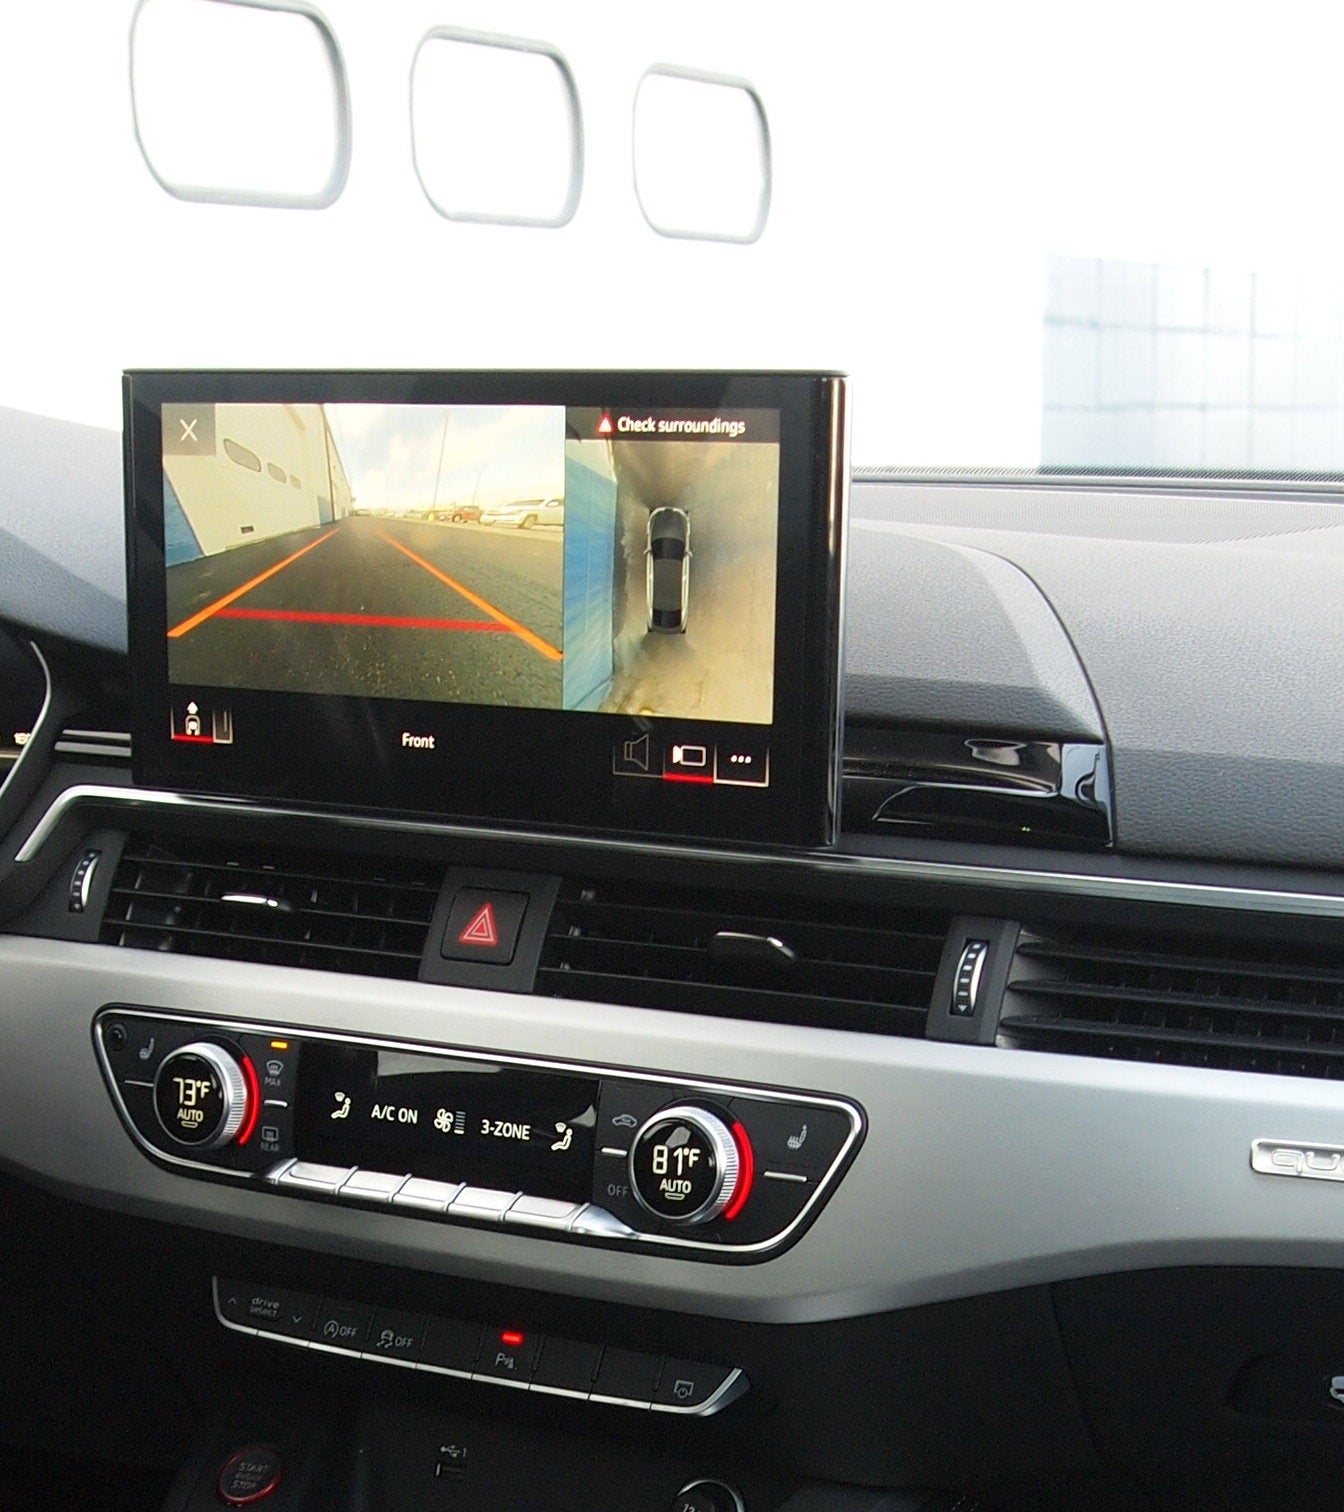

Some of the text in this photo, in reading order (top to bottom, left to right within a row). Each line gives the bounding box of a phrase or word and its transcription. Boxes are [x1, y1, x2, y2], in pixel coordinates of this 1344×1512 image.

[617, 416, 746, 438] Check surroundings
[402, 732, 435, 749] Front
[264, 1077, 282, 1087] MAX
[177, 1107, 204, 1123] AUTO
[371, 1104, 419, 1124] A/C ON
[480, 1118, 531, 1141] 3-ZONE
[608, 1184, 629, 1198] OFF
[660, 1180, 692, 1194] AUTO
[251, 1297, 281, 1310] drive
[339, 1326, 358, 1338] OFF
[395, 1336, 414, 1348] OFF
